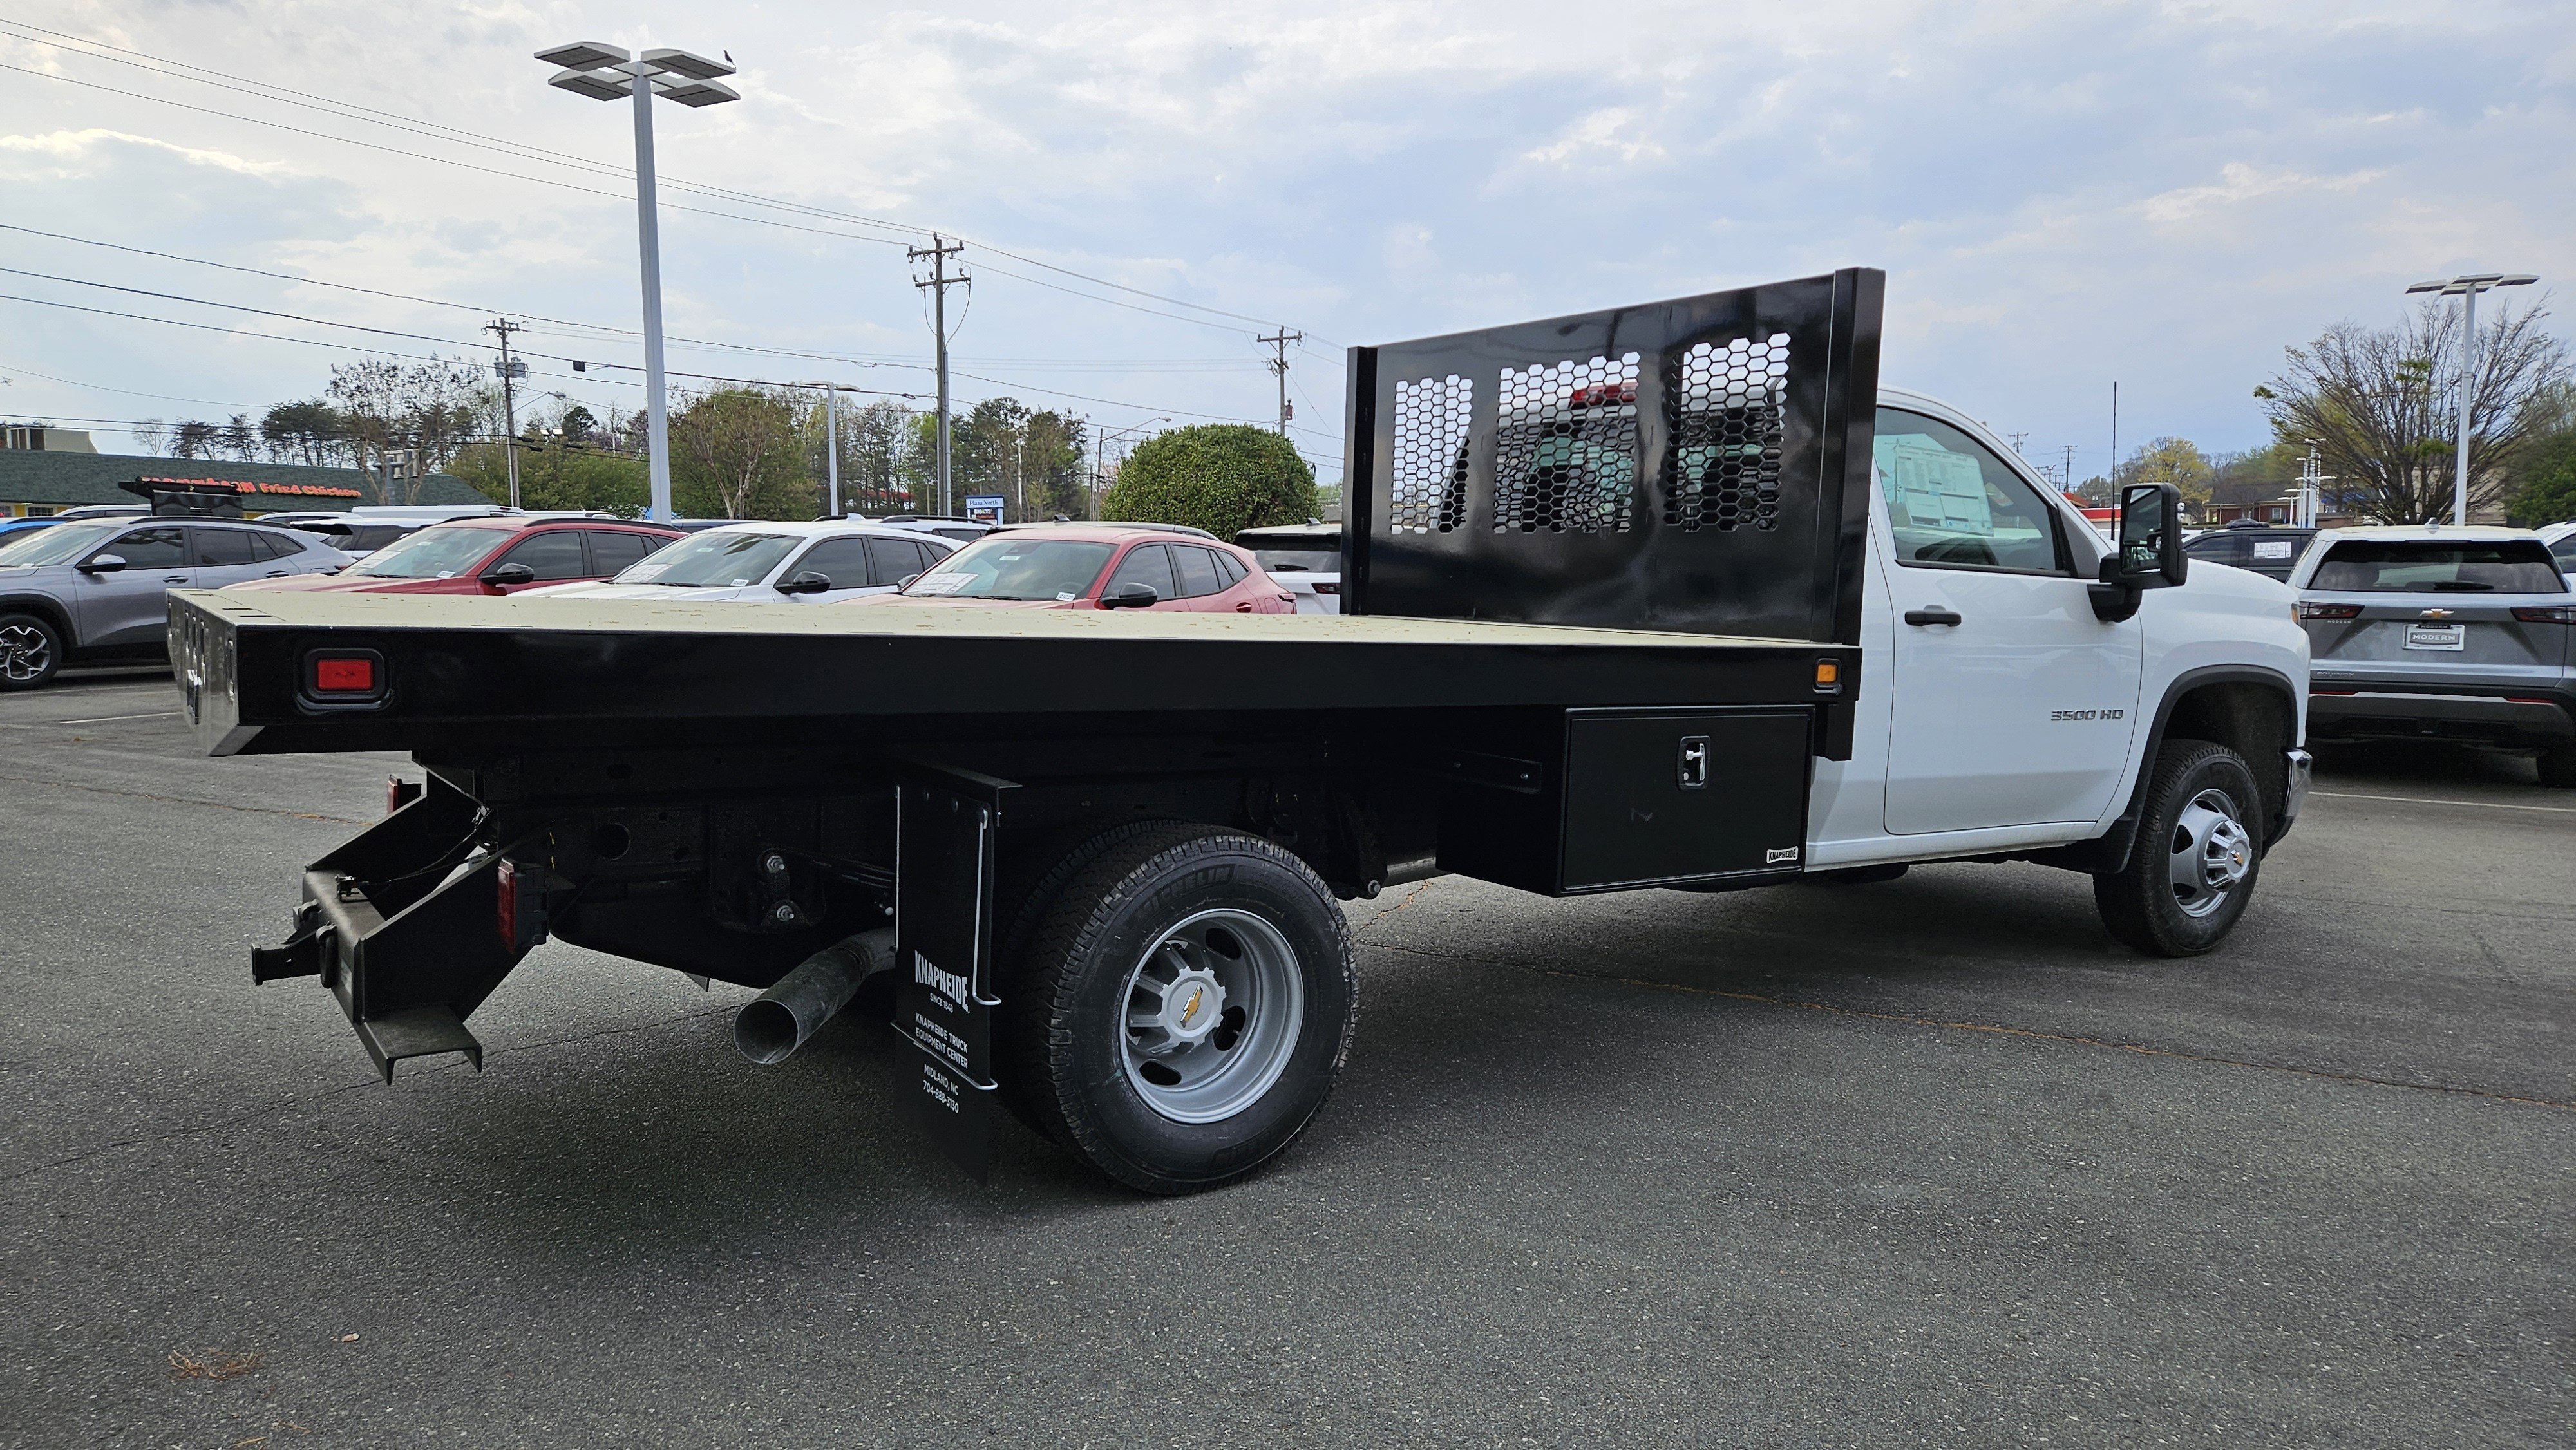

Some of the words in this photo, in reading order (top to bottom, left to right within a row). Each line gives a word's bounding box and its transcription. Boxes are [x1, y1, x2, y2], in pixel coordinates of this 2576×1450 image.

[259, 483, 302, 494] Fried
[301, 485, 361, 497] Chicken
[2050, 710, 2096, 721] 3500
[2100, 709, 2124, 720] HD
[1769, 848, 1797, 862] KNAPHEIDE
[914, 949, 969, 1013] KNAPHEIDE
[930, 992, 943, 1007] SINCE
[915, 1012, 948, 1040] KNAPHEIDE
[949, 1032, 968, 1054] TRUCK
[915, 1026, 947, 1054] EQUIPMENT
[946, 1046, 968, 1069] CENTER
[924, 1063, 950, 1091] MIDLAND,
[950, 1082, 959, 1095] NC
[923, 1080, 959, 1114] 704-888-3130
